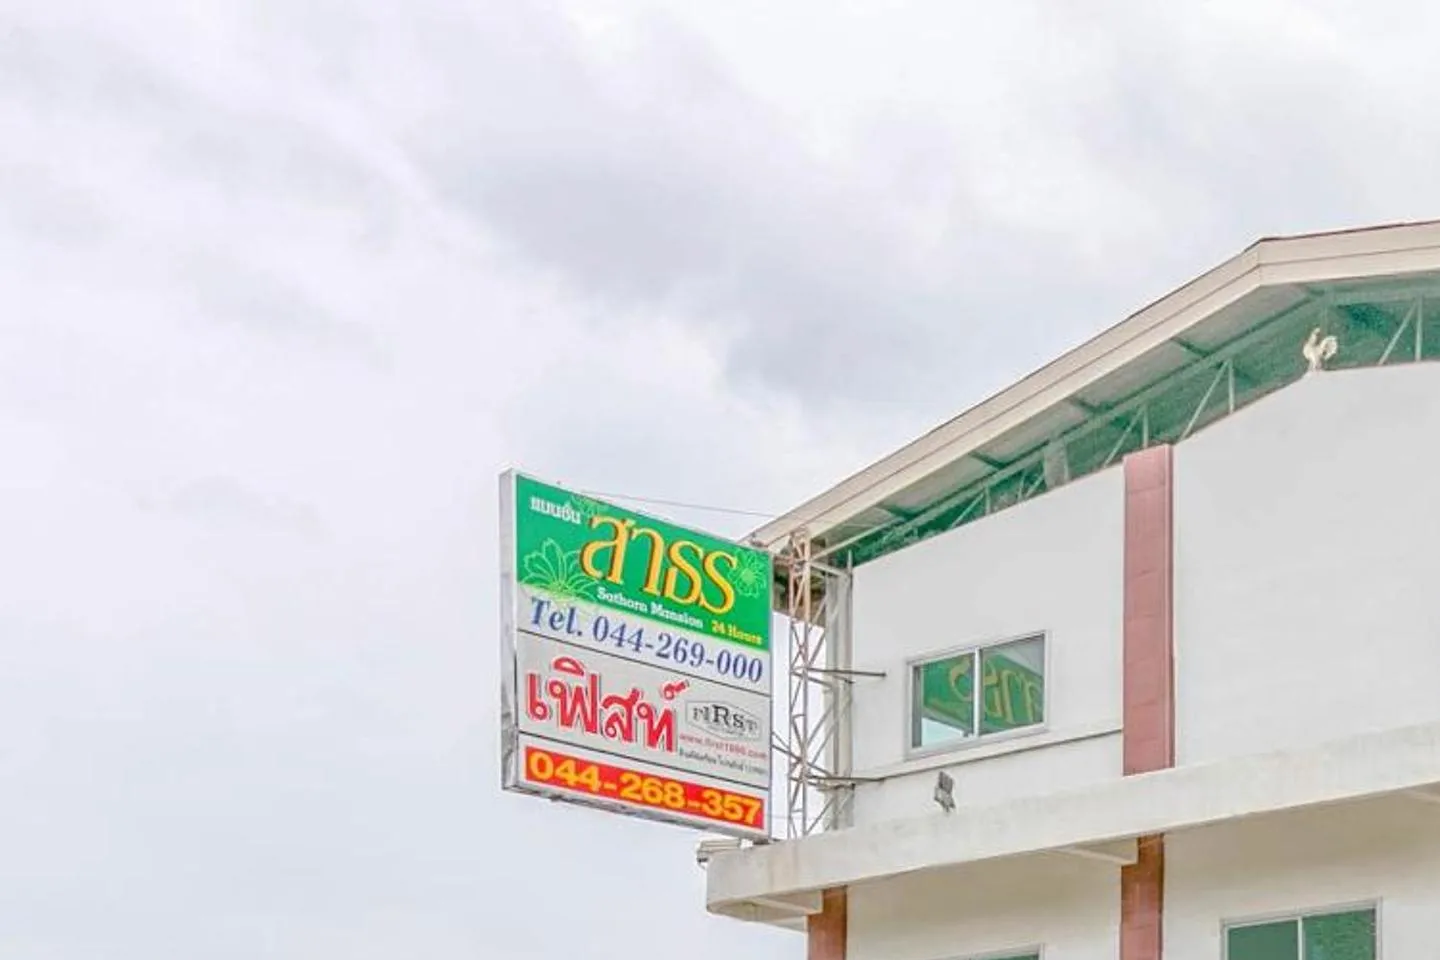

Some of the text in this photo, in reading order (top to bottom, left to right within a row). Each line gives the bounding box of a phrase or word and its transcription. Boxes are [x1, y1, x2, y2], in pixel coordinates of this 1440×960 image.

[579, 514, 736, 615] สาธร
[530, 596, 764, 684] Tel. 044-269-000
[650, 601, 704, 629] Mansion
[526, 655, 691, 753] เฟิสท์
[529, 751, 762, 825] 044-268-357
